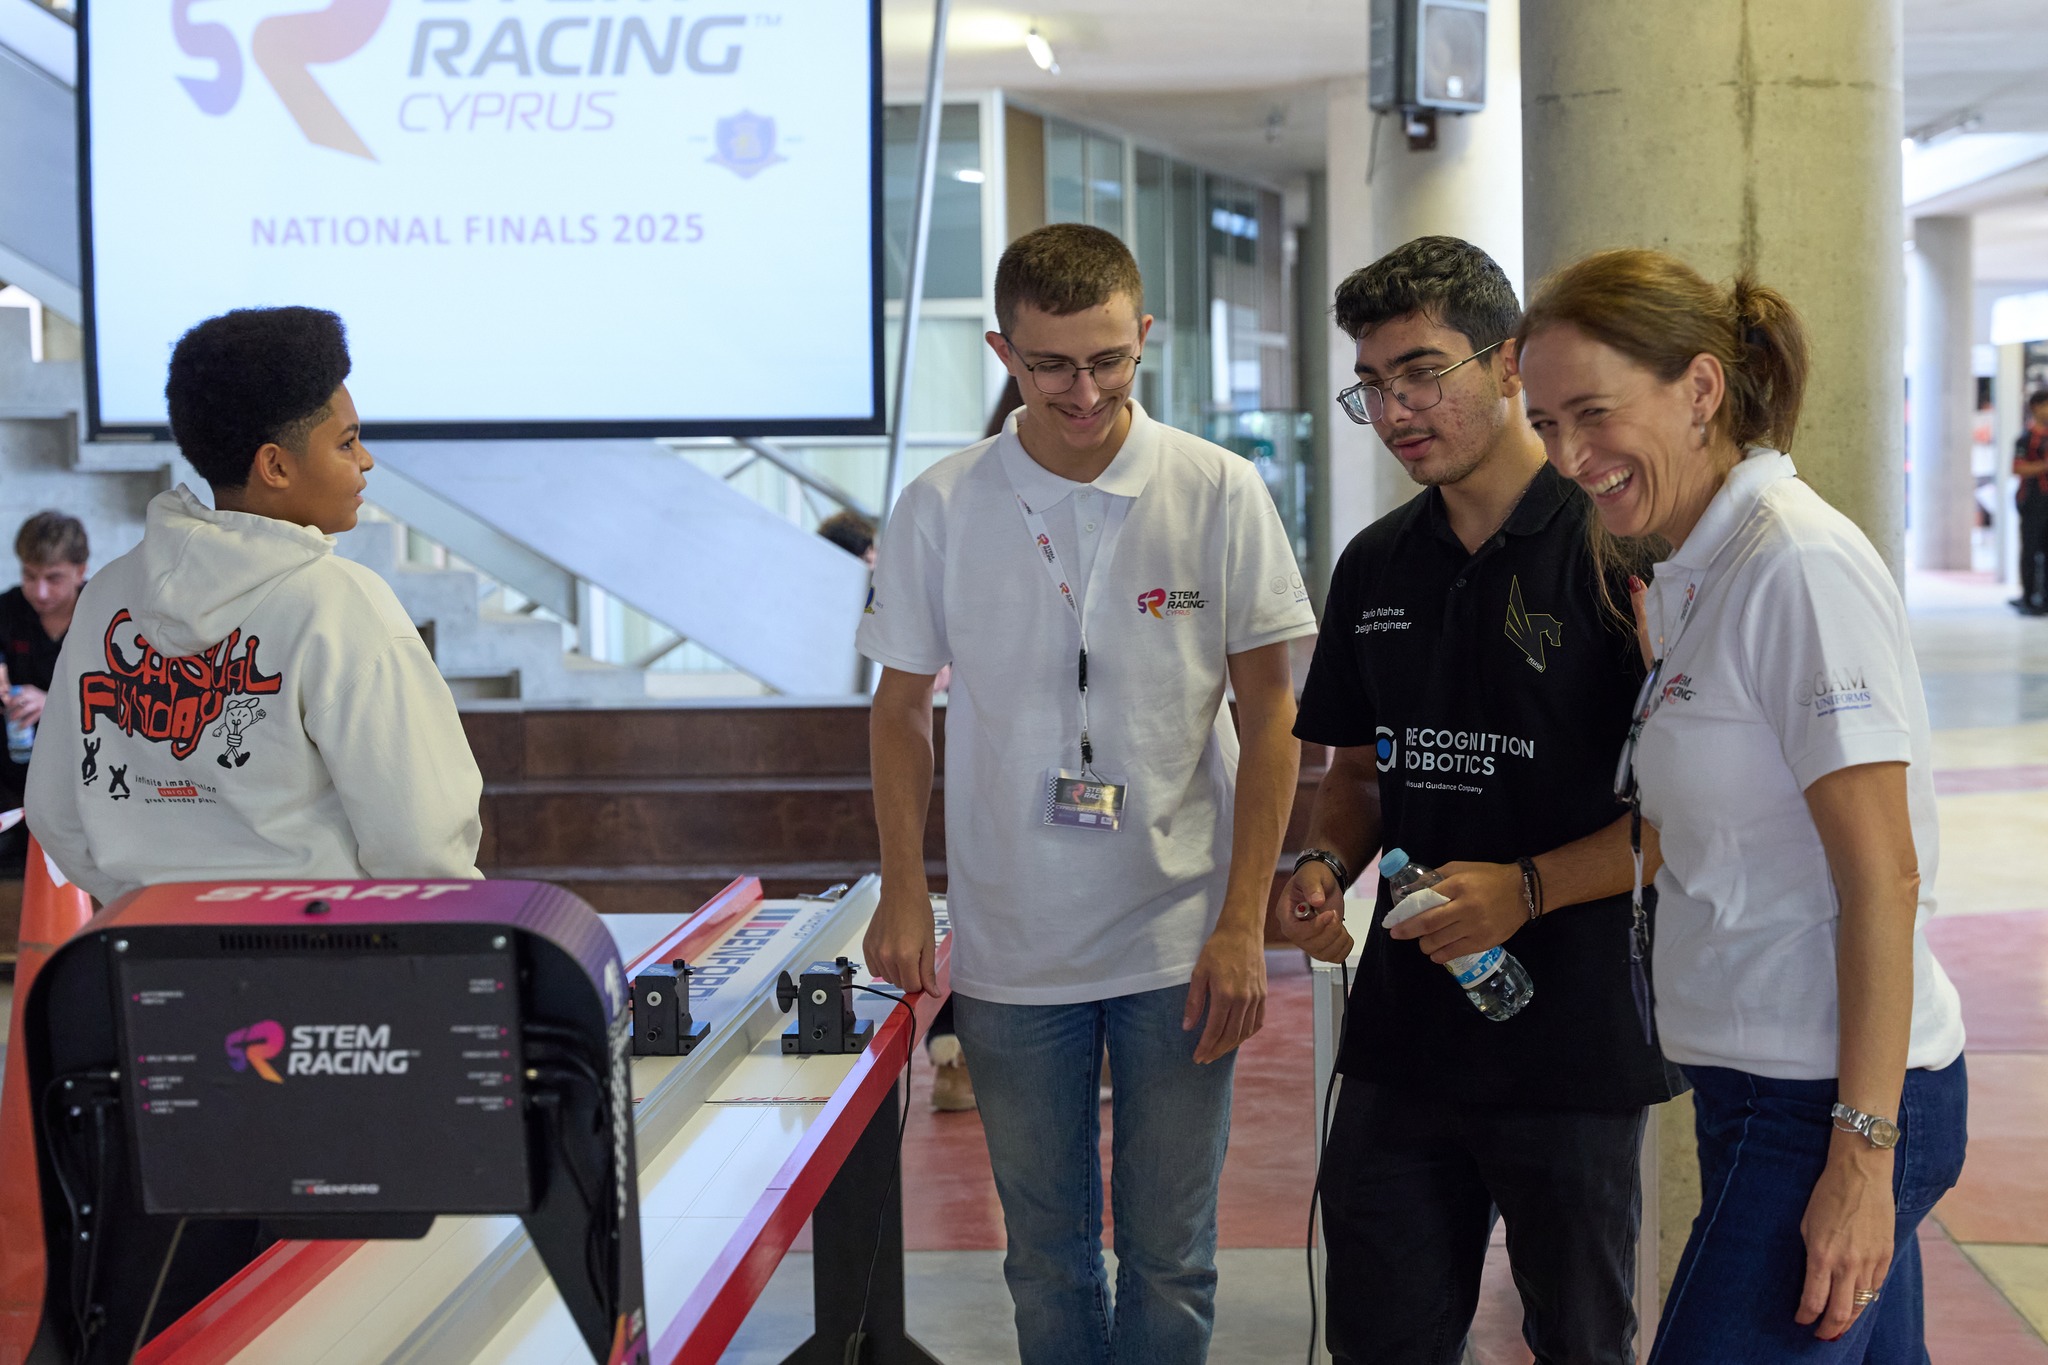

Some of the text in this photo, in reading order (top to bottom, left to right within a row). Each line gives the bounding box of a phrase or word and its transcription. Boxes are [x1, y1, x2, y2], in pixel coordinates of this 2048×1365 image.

[407, 15, 747, 78] RACING
[398, 91, 619, 132] CYPRUS
[251, 213, 705, 247] NATIONAL FINALS 2025
[1167, 600, 1205, 609] RACING
[1168, 591, 1200, 600] STEM
[1376, 606, 1405, 616] Nahas
[1373, 620, 1412, 632] Engineer
[1815, 691, 1871, 711] UNIFORMS
[1405, 727, 1535, 759] RECOGNITION
[1425, 781, 1457, 791] Guidance
[194, 884, 472, 902] START
[689, 928, 781, 1001] DENFORD
[290, 1023, 391, 1049] STEM
[286, 1050, 410, 1075] RACING
